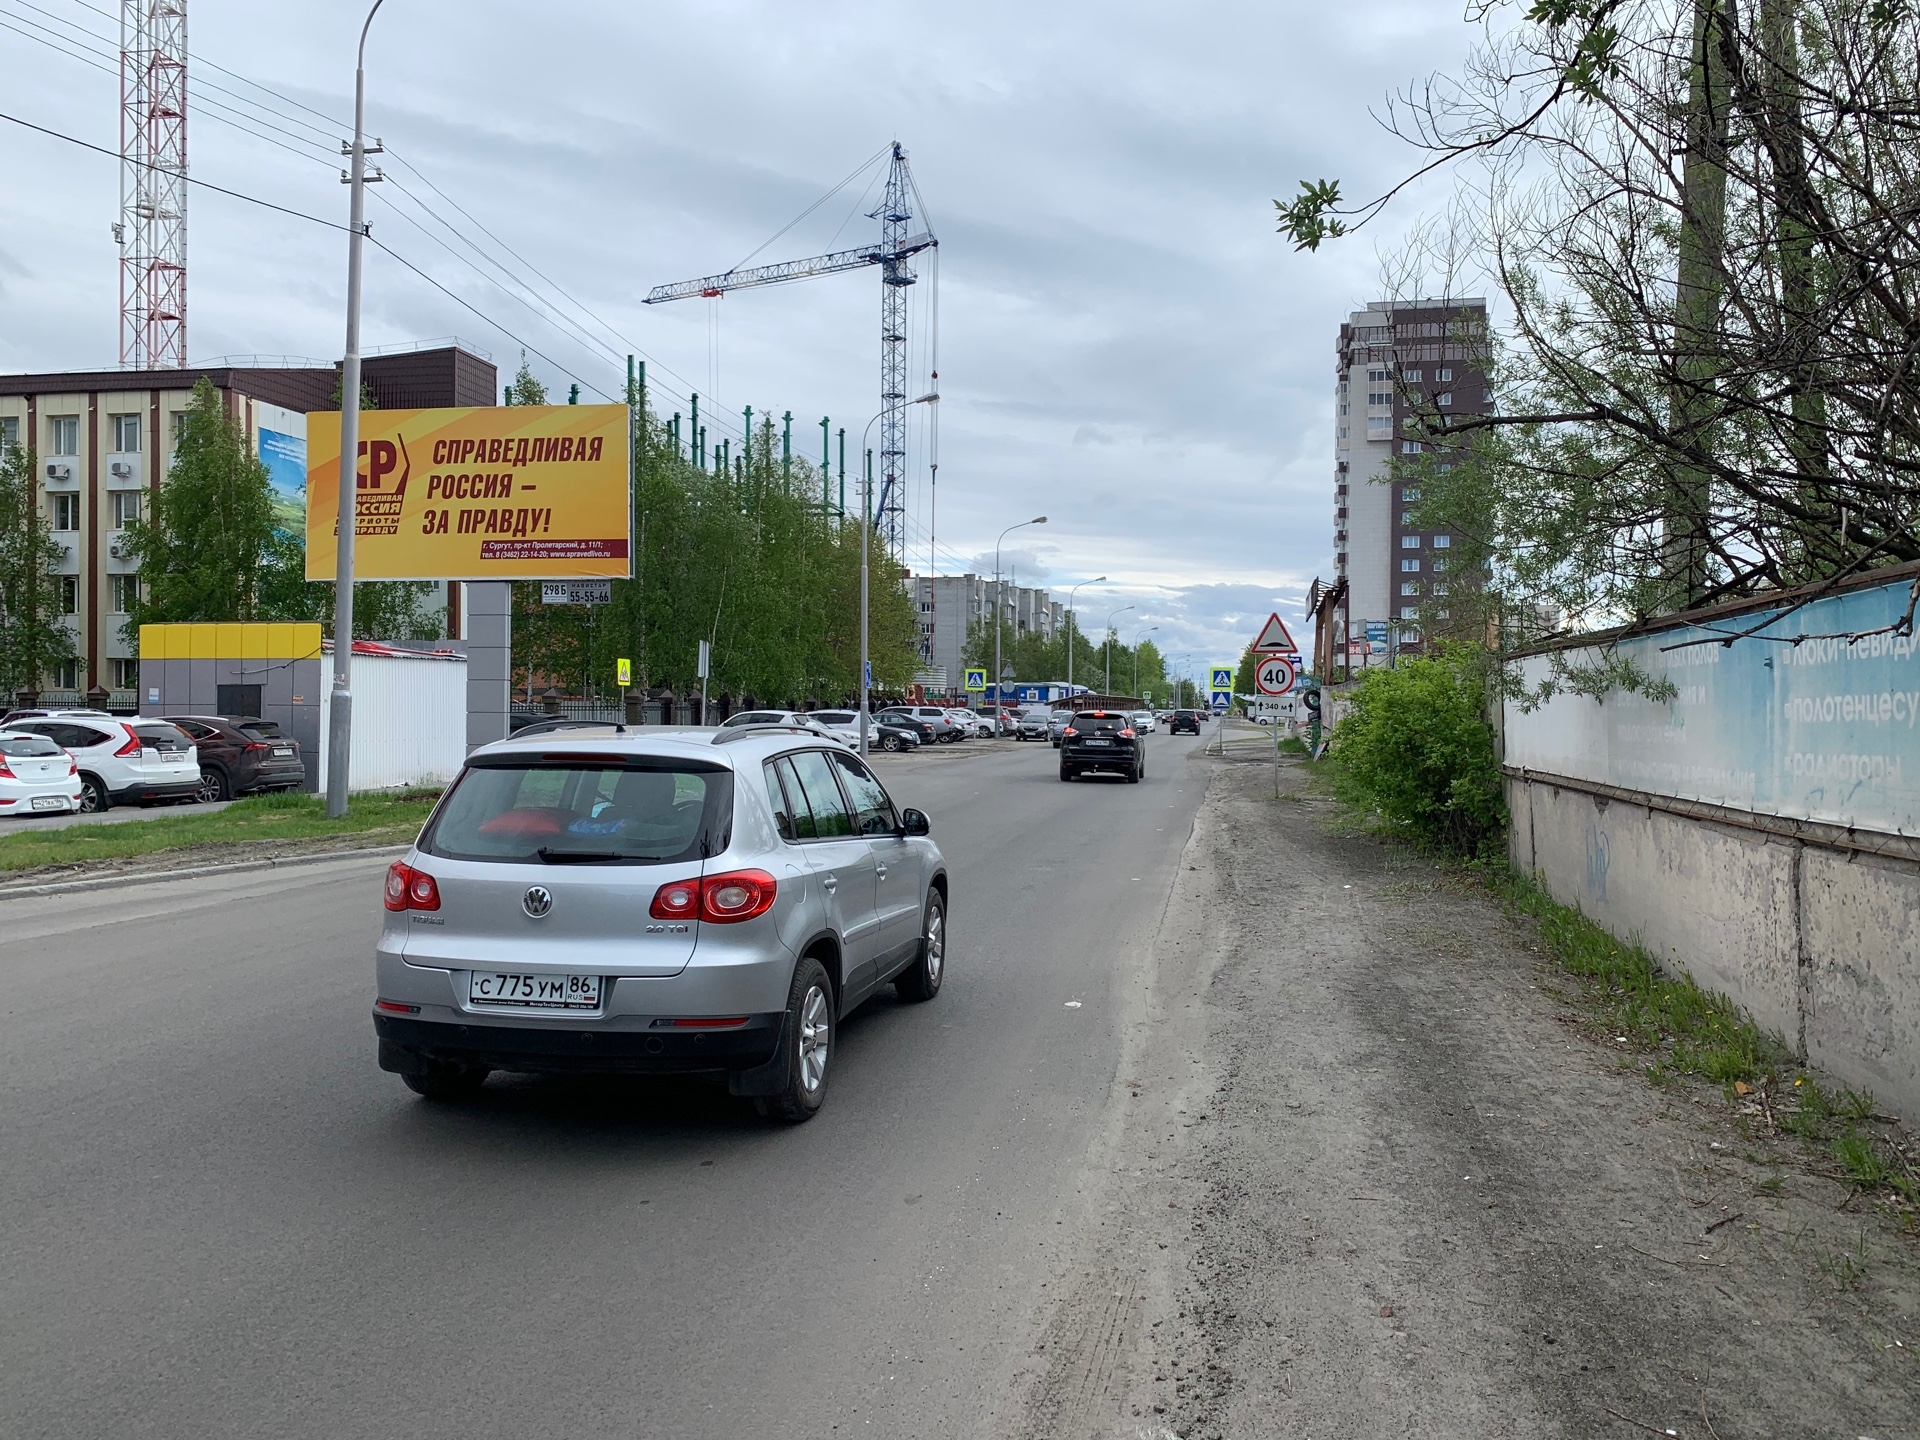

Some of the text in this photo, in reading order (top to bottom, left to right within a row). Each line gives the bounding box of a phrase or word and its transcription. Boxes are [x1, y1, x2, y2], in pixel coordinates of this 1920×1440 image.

[432, 436, 603, 467] СПРАВЕДЛИВАЯ
[426, 473, 513, 499] РОССИЯ
[356, 494, 402, 503] АВЕДЛИВАЯ
[355, 502, 401, 514] ОССИЯ
[422, 508, 552, 538] ЗА ПРАВДУ!
[489, 542, 513, 551] Сургут,
[514, 542, 531, 550] пр-кт
[532, 541, 579, 550] Пролетарский,
[500, 551, 520, 559] (3462)
[520, 551, 549, 559] 22-14-20;
[550, 551, 610, 559] www.spravedlivo.ru
[570, 591, 609, 602] 55-55-66
[1263, 669, 1286, 684] 40
[667, 924, 689, 934] TSI
[569, 976, 591, 993] 86
